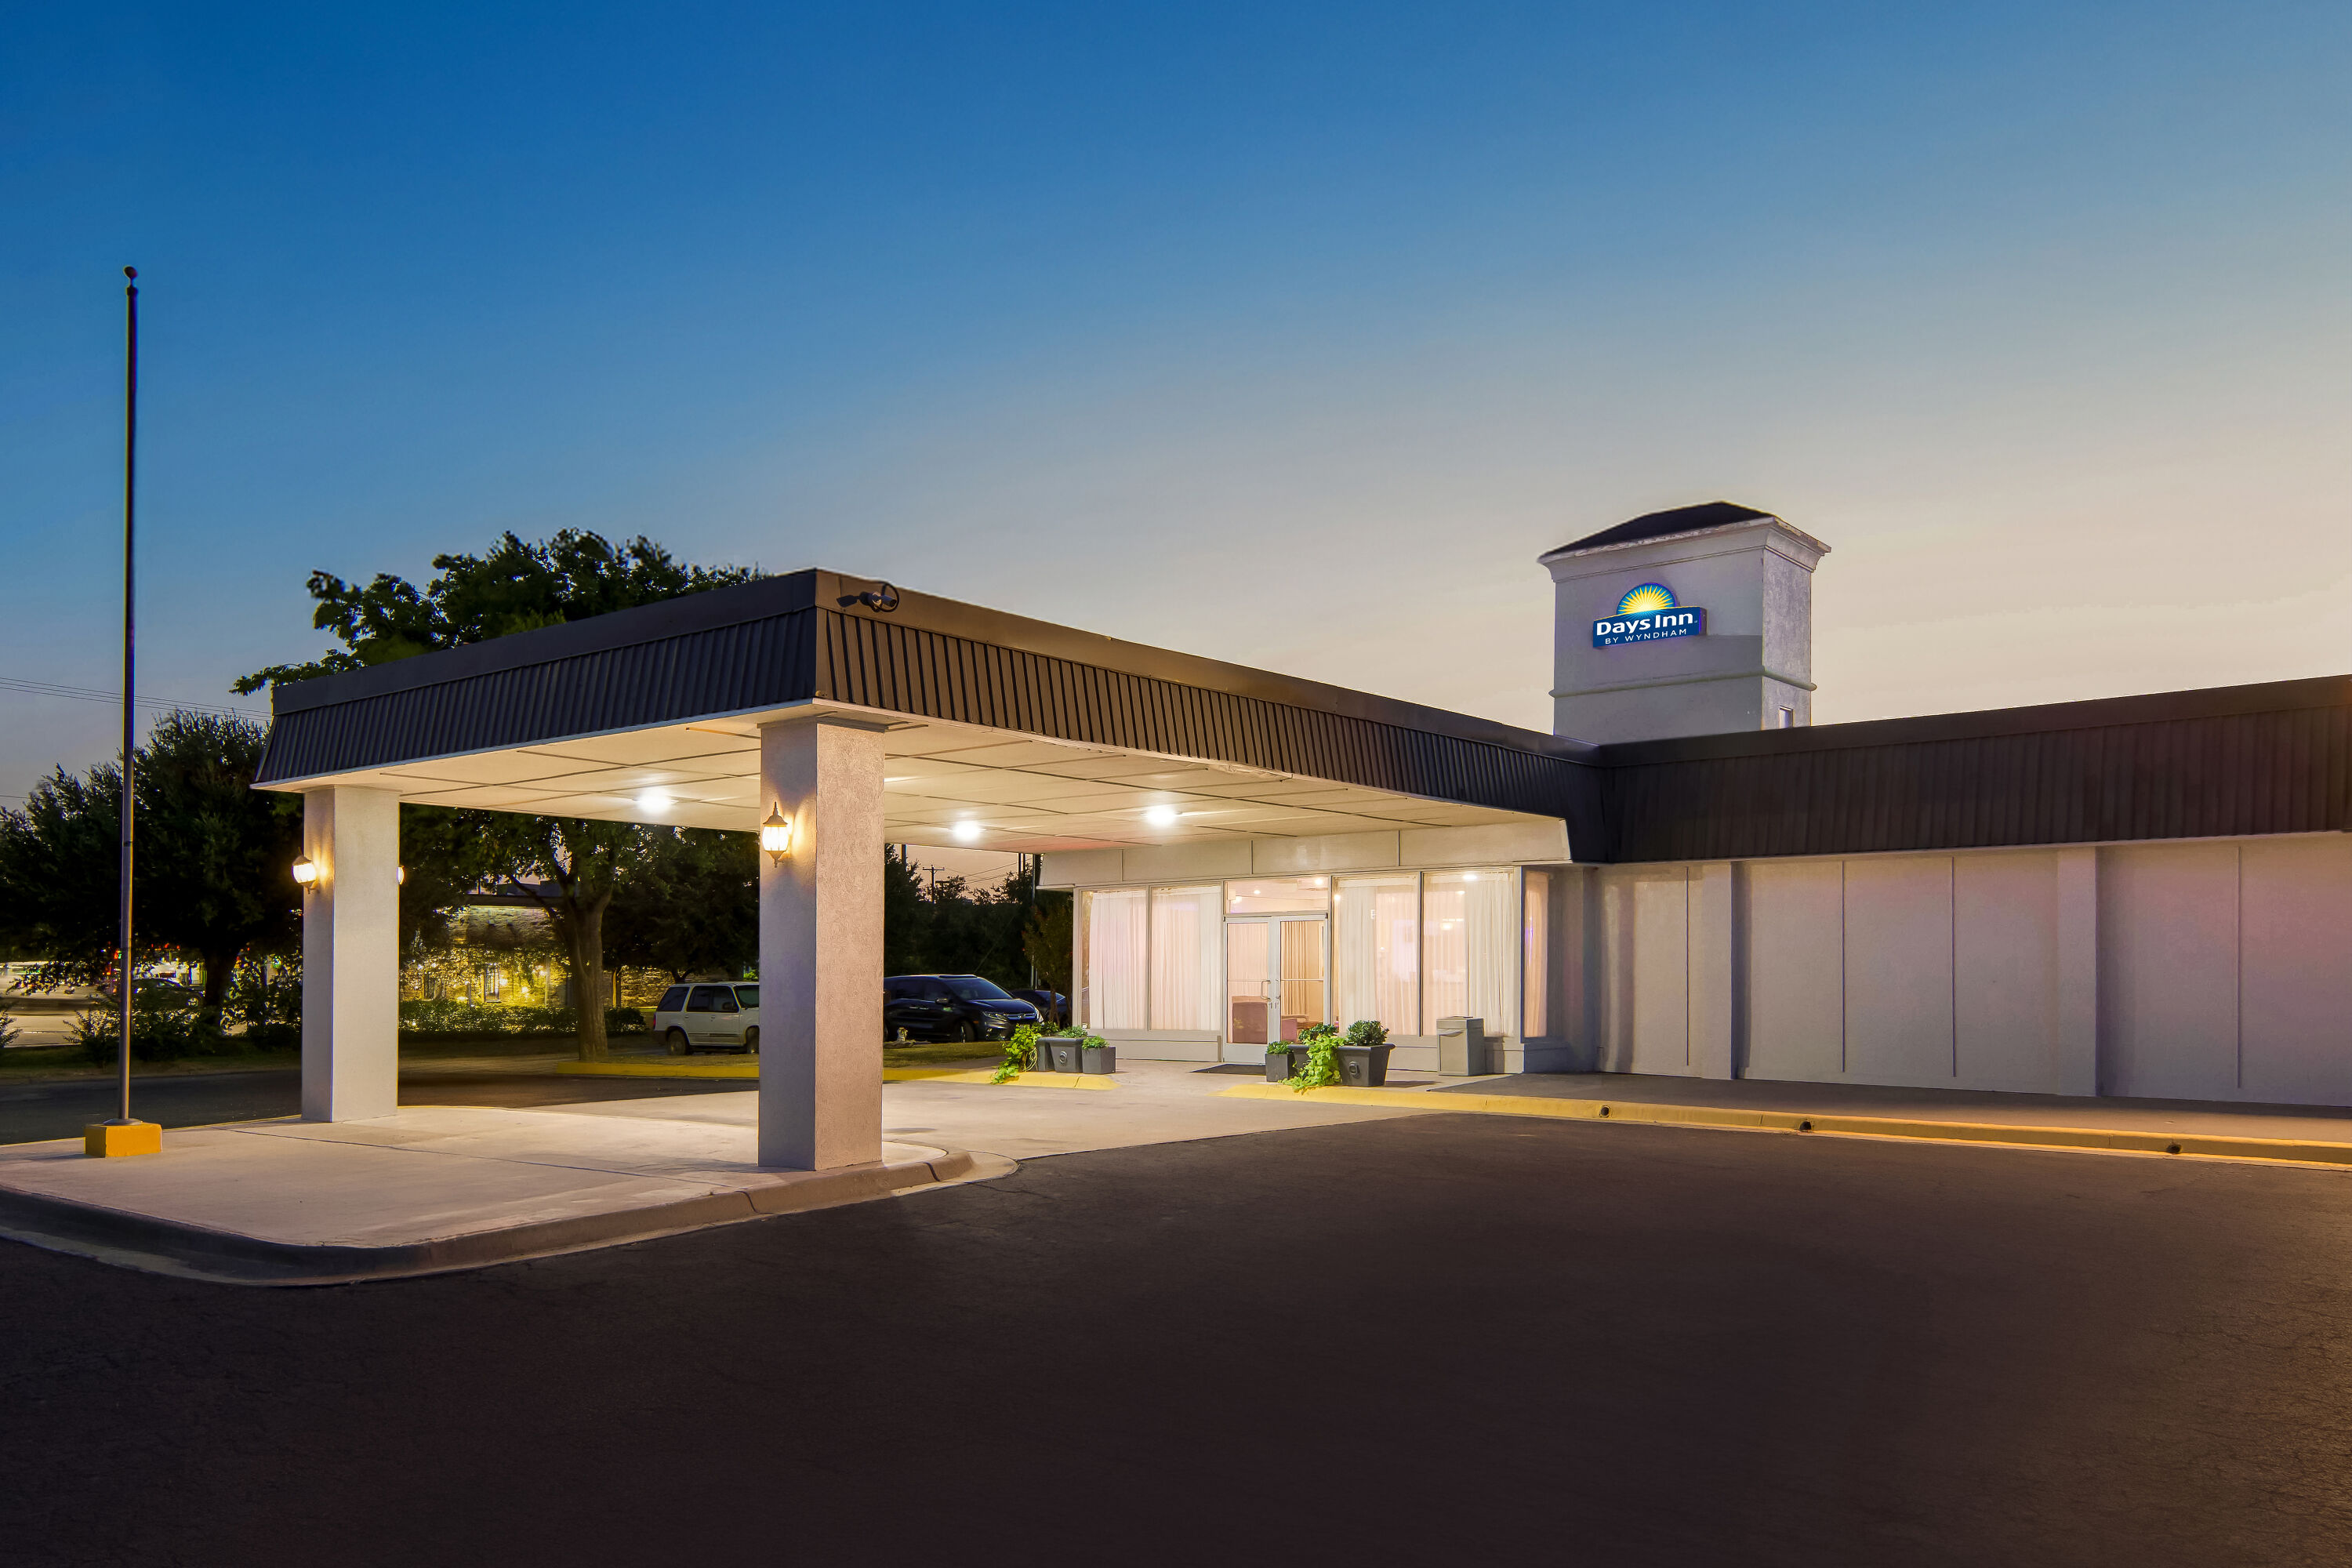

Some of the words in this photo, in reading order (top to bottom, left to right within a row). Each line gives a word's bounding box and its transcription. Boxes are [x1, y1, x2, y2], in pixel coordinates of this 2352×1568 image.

[1596, 619, 1650, 635] Days
[1655, 613, 1693, 629] Inn
[1624, 629, 1686, 641] WYNDHAM
